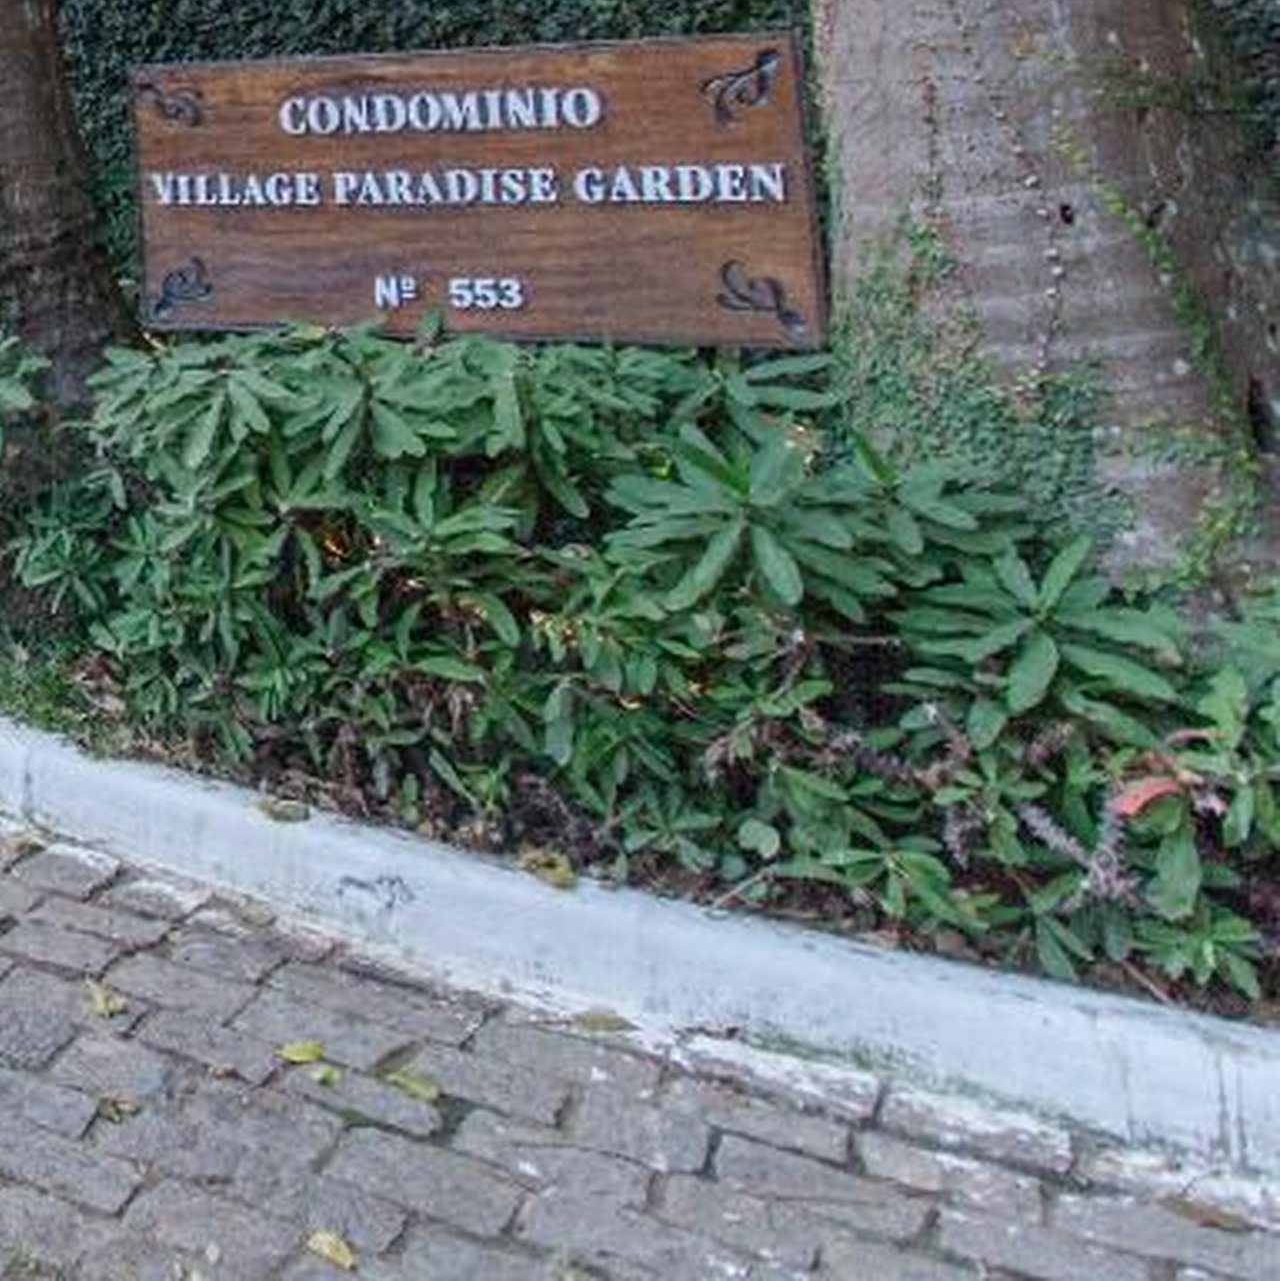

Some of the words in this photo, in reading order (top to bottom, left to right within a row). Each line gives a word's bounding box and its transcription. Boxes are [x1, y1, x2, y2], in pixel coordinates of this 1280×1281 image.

[278, 86, 603, 135] CONDOMINIO
[150, 171, 321, 206] VILLAGE
[332, 168, 559, 206] PARADISE
[572, 163, 787, 204] GARDEN
[448, 276, 525, 310] 553
